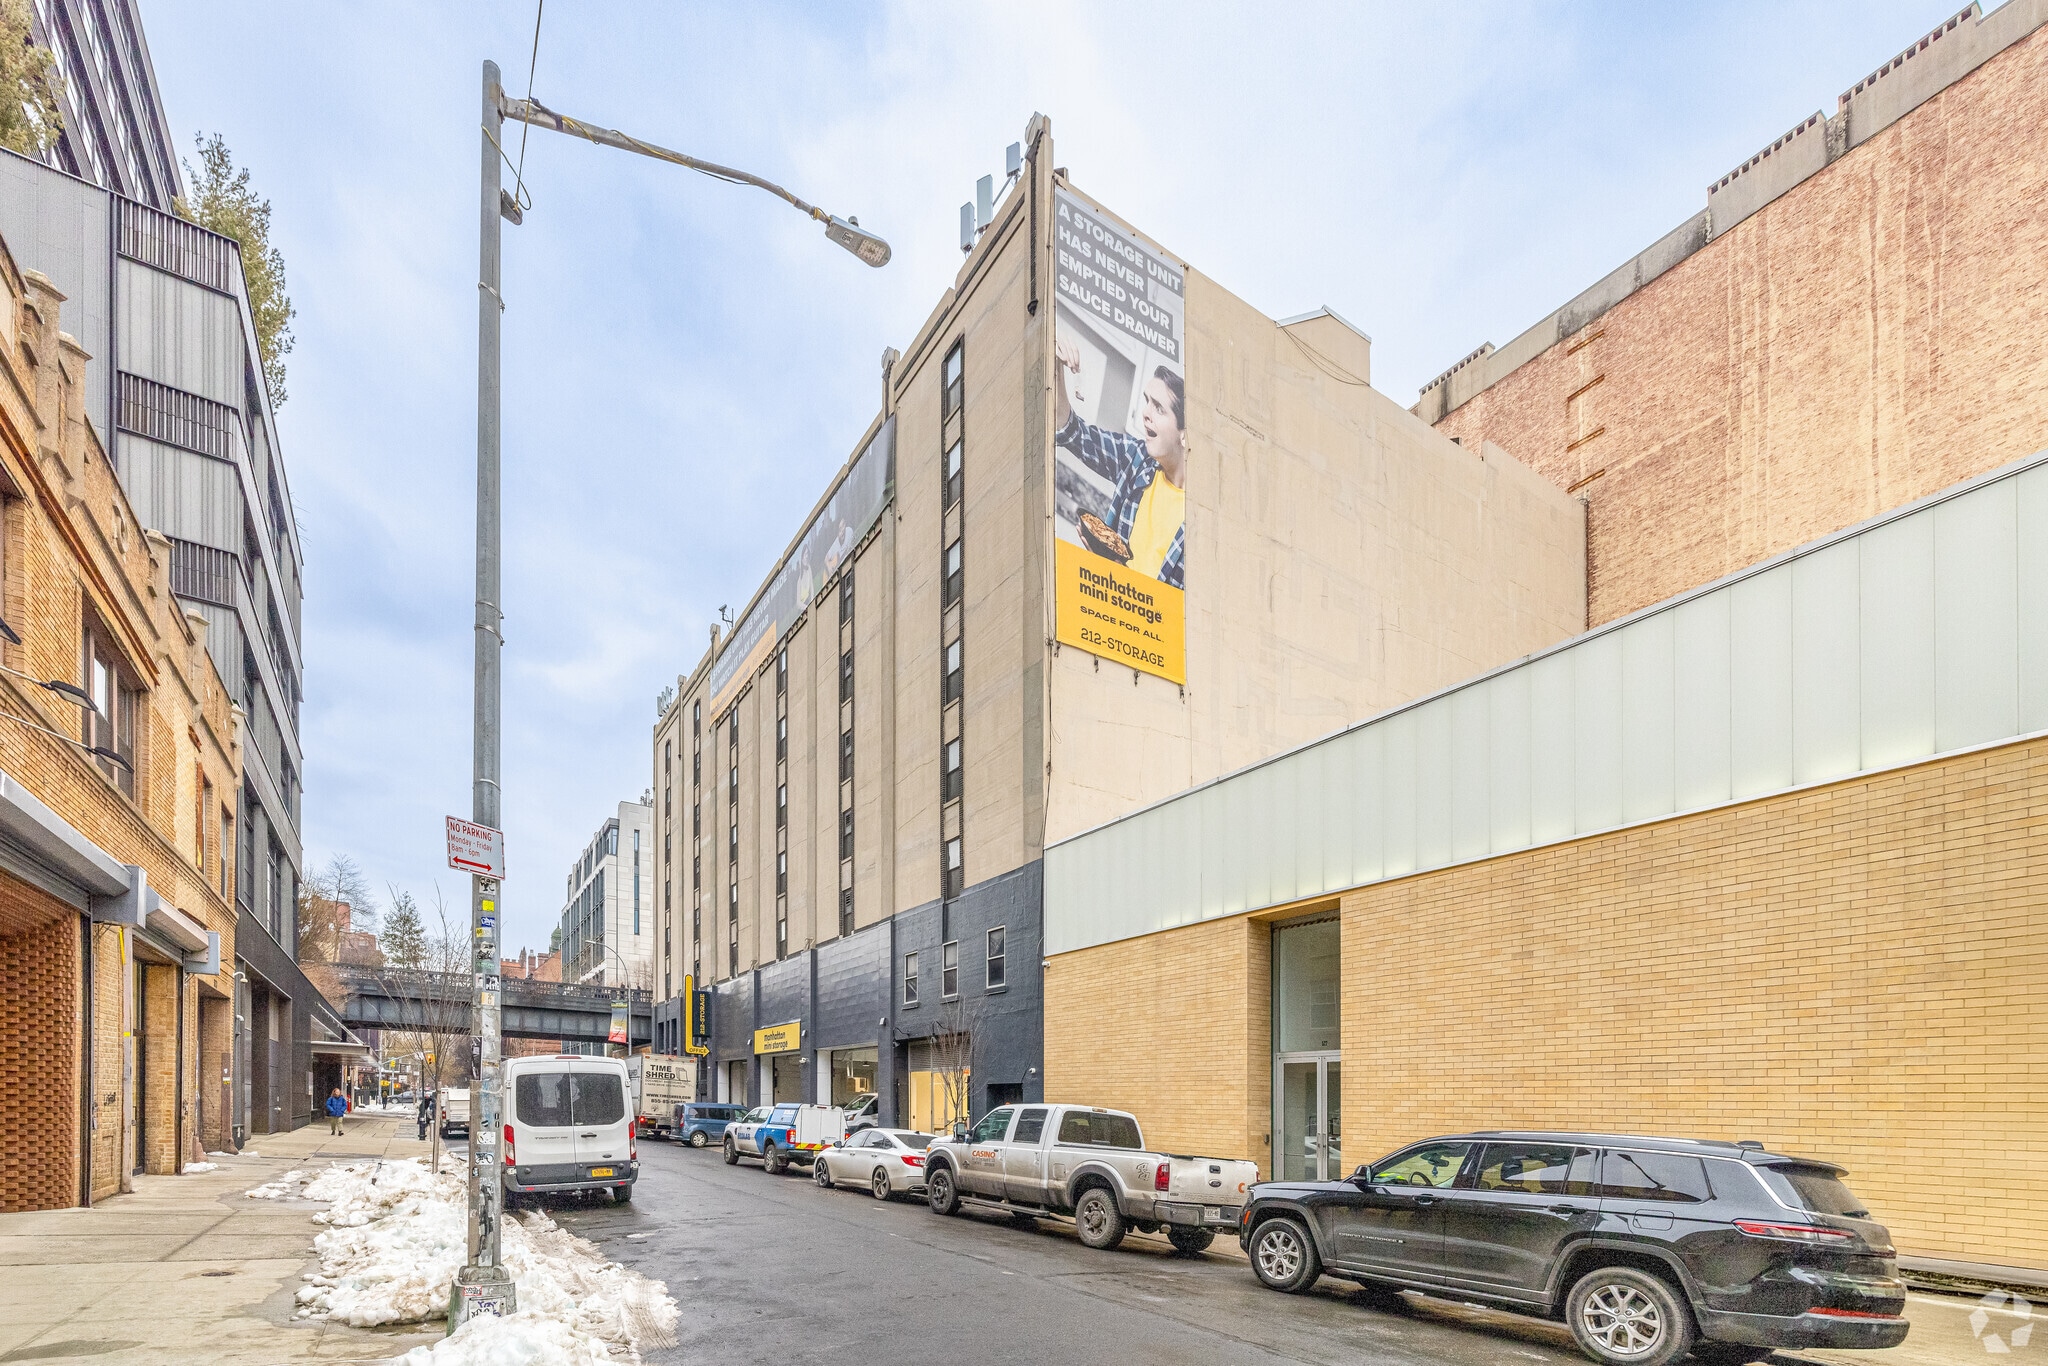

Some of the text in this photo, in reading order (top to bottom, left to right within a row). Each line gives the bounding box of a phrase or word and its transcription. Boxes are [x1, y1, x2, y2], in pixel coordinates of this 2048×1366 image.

[1058, 203, 1181, 291] A STORAGE UNIT
[1059, 226, 1144, 292] HAS NEVER
[1059, 249, 1170, 330] EMPTIED YOUR
[1059, 274, 1176, 355] SAUCE DRAWER
[753, 594, 770, 624] NEVER
[770, 570, 787, 600] MADE
[1079, 566, 1154, 607] manhattan
[1079, 582, 1163, 625] mini storage
[751, 614, 769, 644] GUITAR
[1080, 605, 1117, 625] SPACE
[1119, 620, 1140, 634] FOR
[1080, 628, 1165, 668] 212-STORAGE
[449, 821, 492, 842] NO PARKING
[450, 834, 471, 847] Monday
[476, 841, 493, 853] Friday
[451, 843, 463, 853] 8am
[468, 848, 480, 857] 6pm
[763, 1031, 786, 1042] manhattan
[645, 1070, 676, 1080] SHRED
[650, 1064, 672, 1072] TIME
[971, 1149, 996, 1158] CASINO
